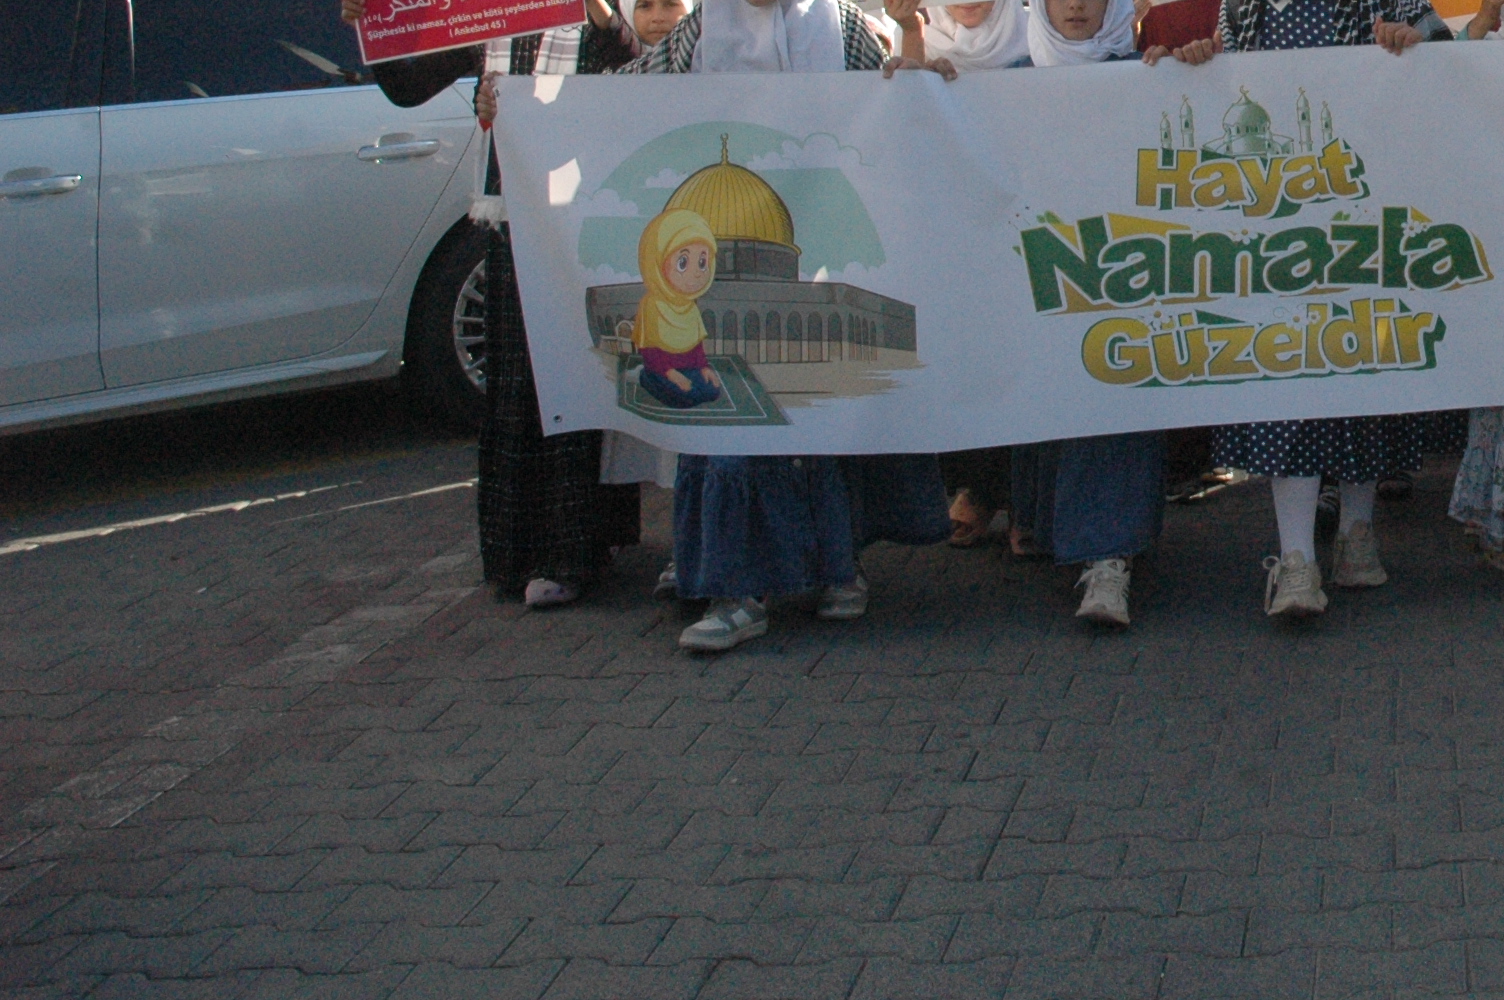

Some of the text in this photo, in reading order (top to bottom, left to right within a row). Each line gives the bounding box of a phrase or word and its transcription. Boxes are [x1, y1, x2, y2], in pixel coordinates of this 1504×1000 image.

[406, 22, 416, 32] ki
[472, 10, 483, 20] ve
[1136, 138, 1372, 218] Hayat
[1018, 204, 1494, 316] Namazla
[1080, 296, 1447, 388] Güzeldir
